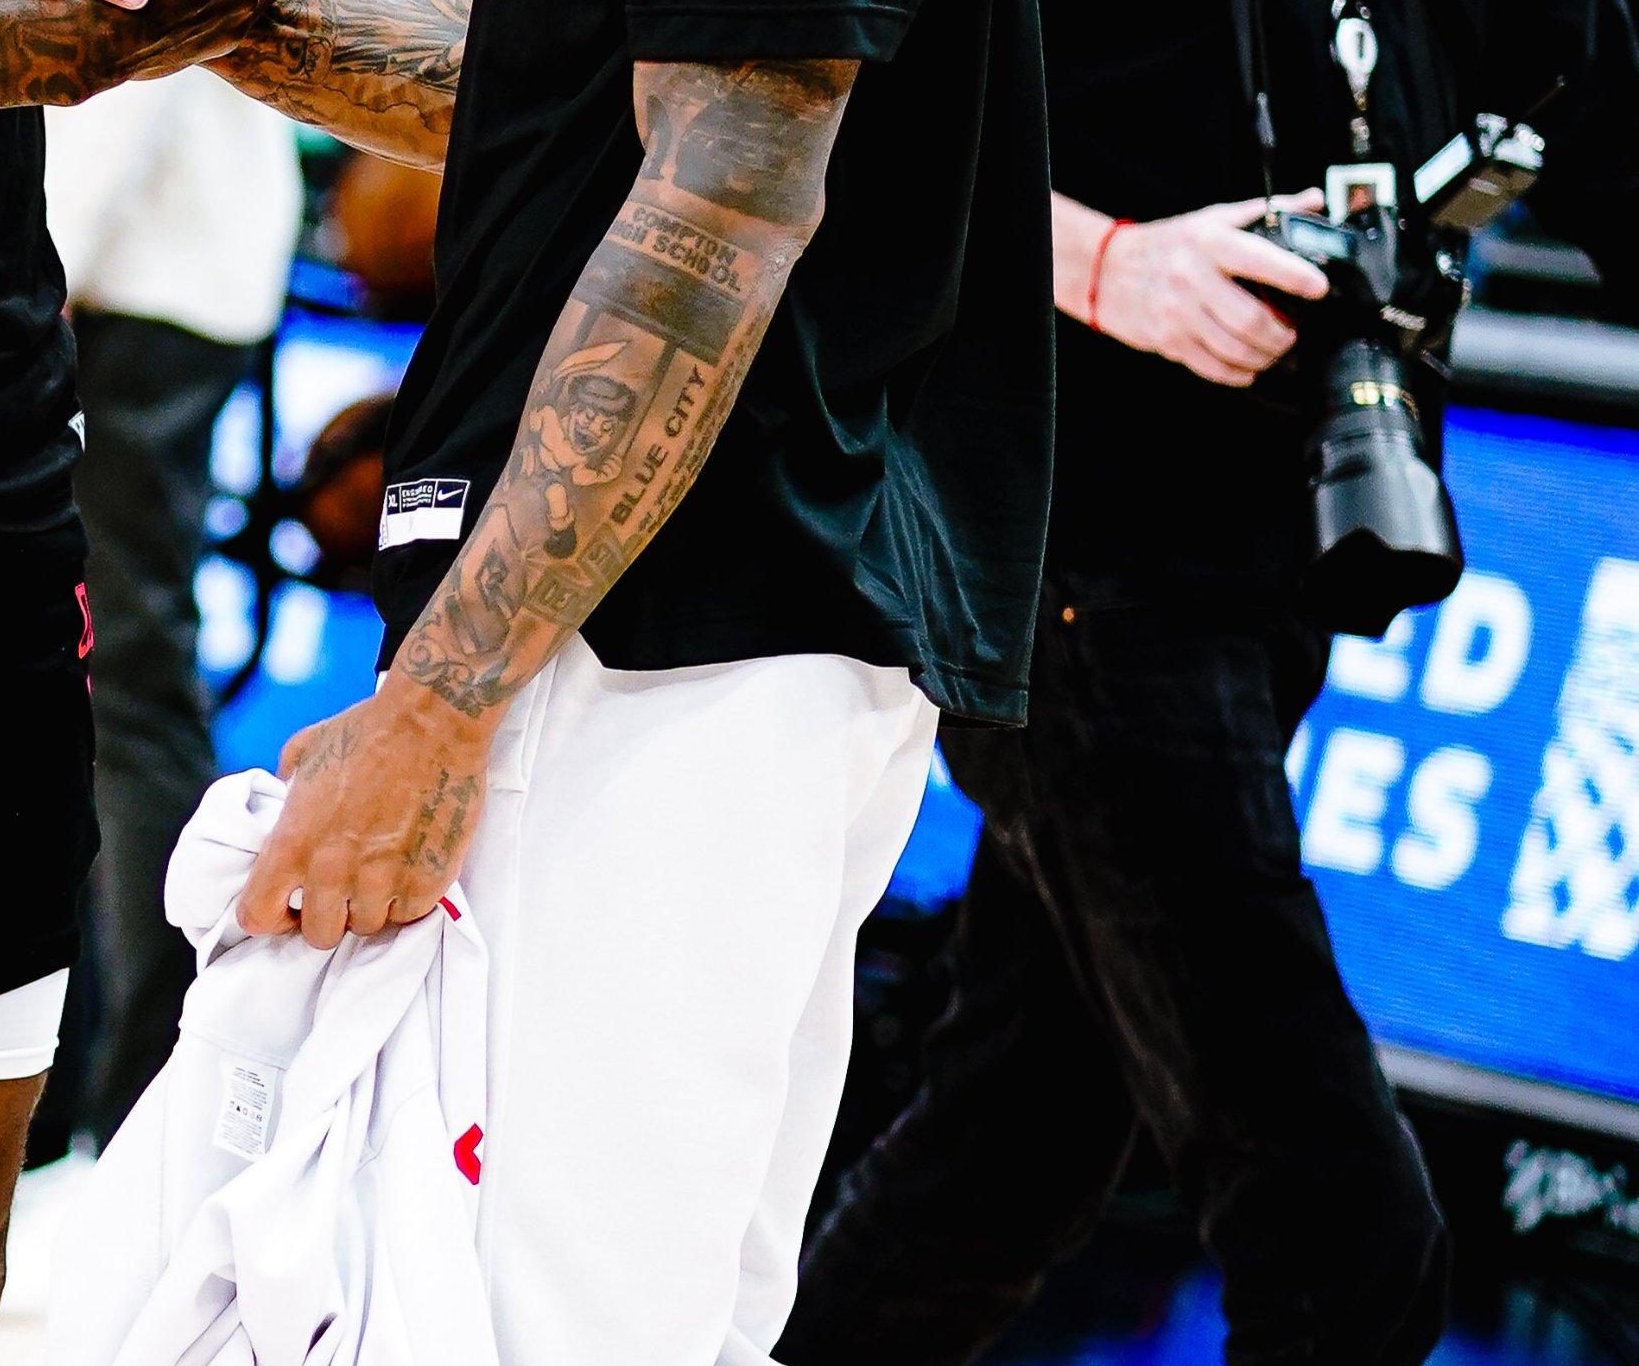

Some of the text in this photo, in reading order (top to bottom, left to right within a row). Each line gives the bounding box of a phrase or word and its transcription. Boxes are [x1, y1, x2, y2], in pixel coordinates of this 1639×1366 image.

[610, 364, 705, 526] BLUE CITY
[387, 494, 398, 508] XL
